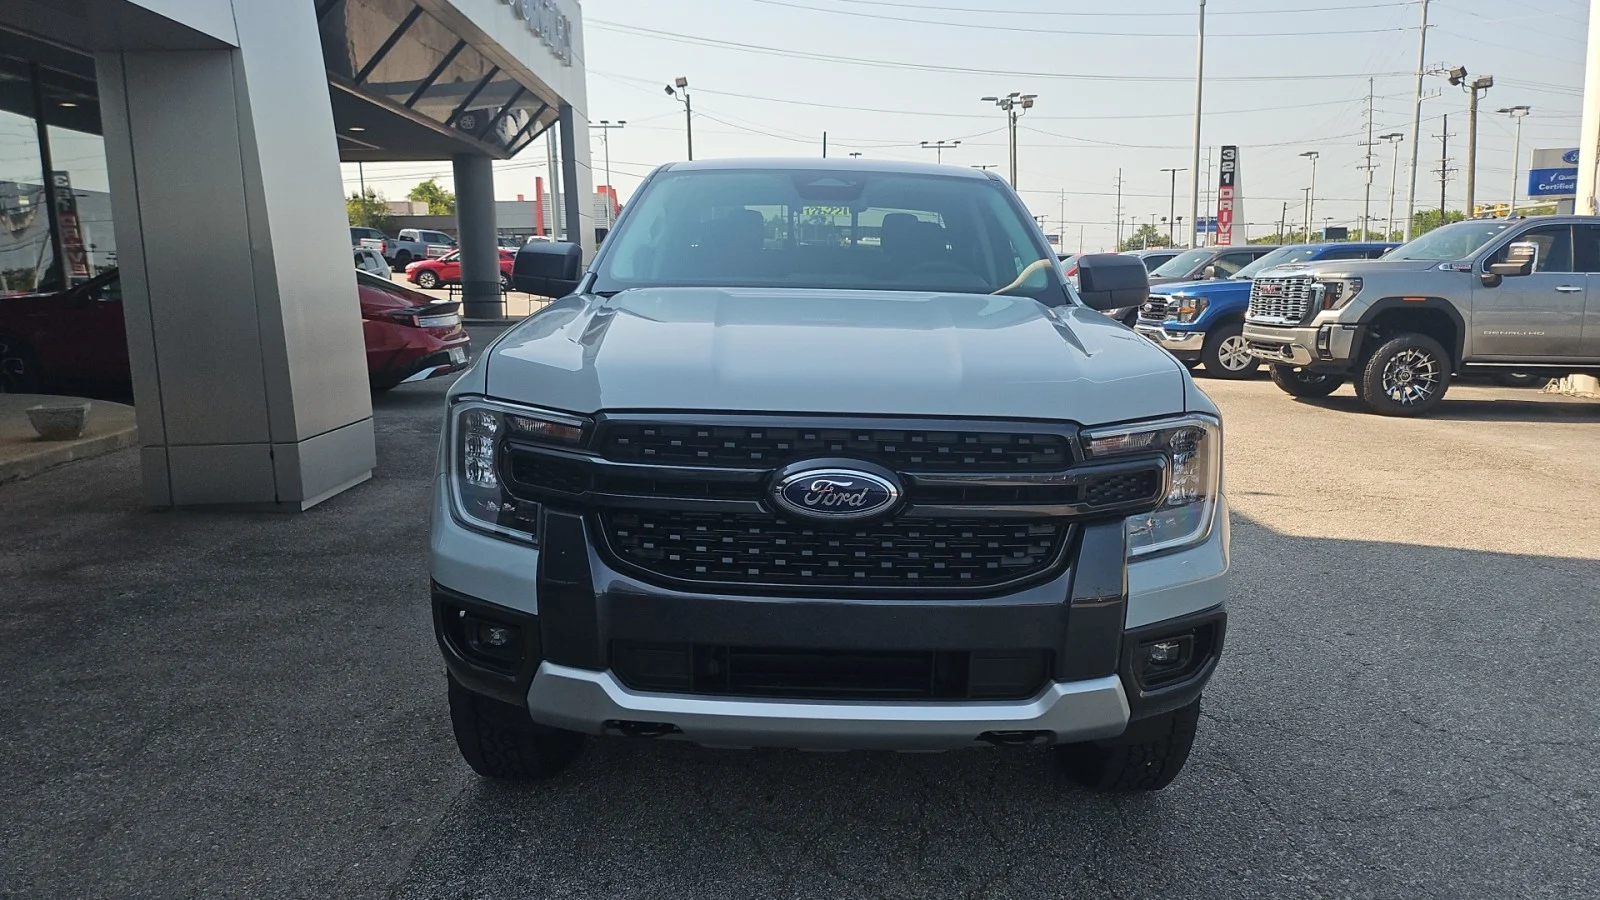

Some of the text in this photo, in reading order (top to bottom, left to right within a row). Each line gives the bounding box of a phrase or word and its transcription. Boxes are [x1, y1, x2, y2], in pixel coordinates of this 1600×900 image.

[1218, 149, 1235, 244] 321 DRIVE
[804, 479, 869, 506] Ford
